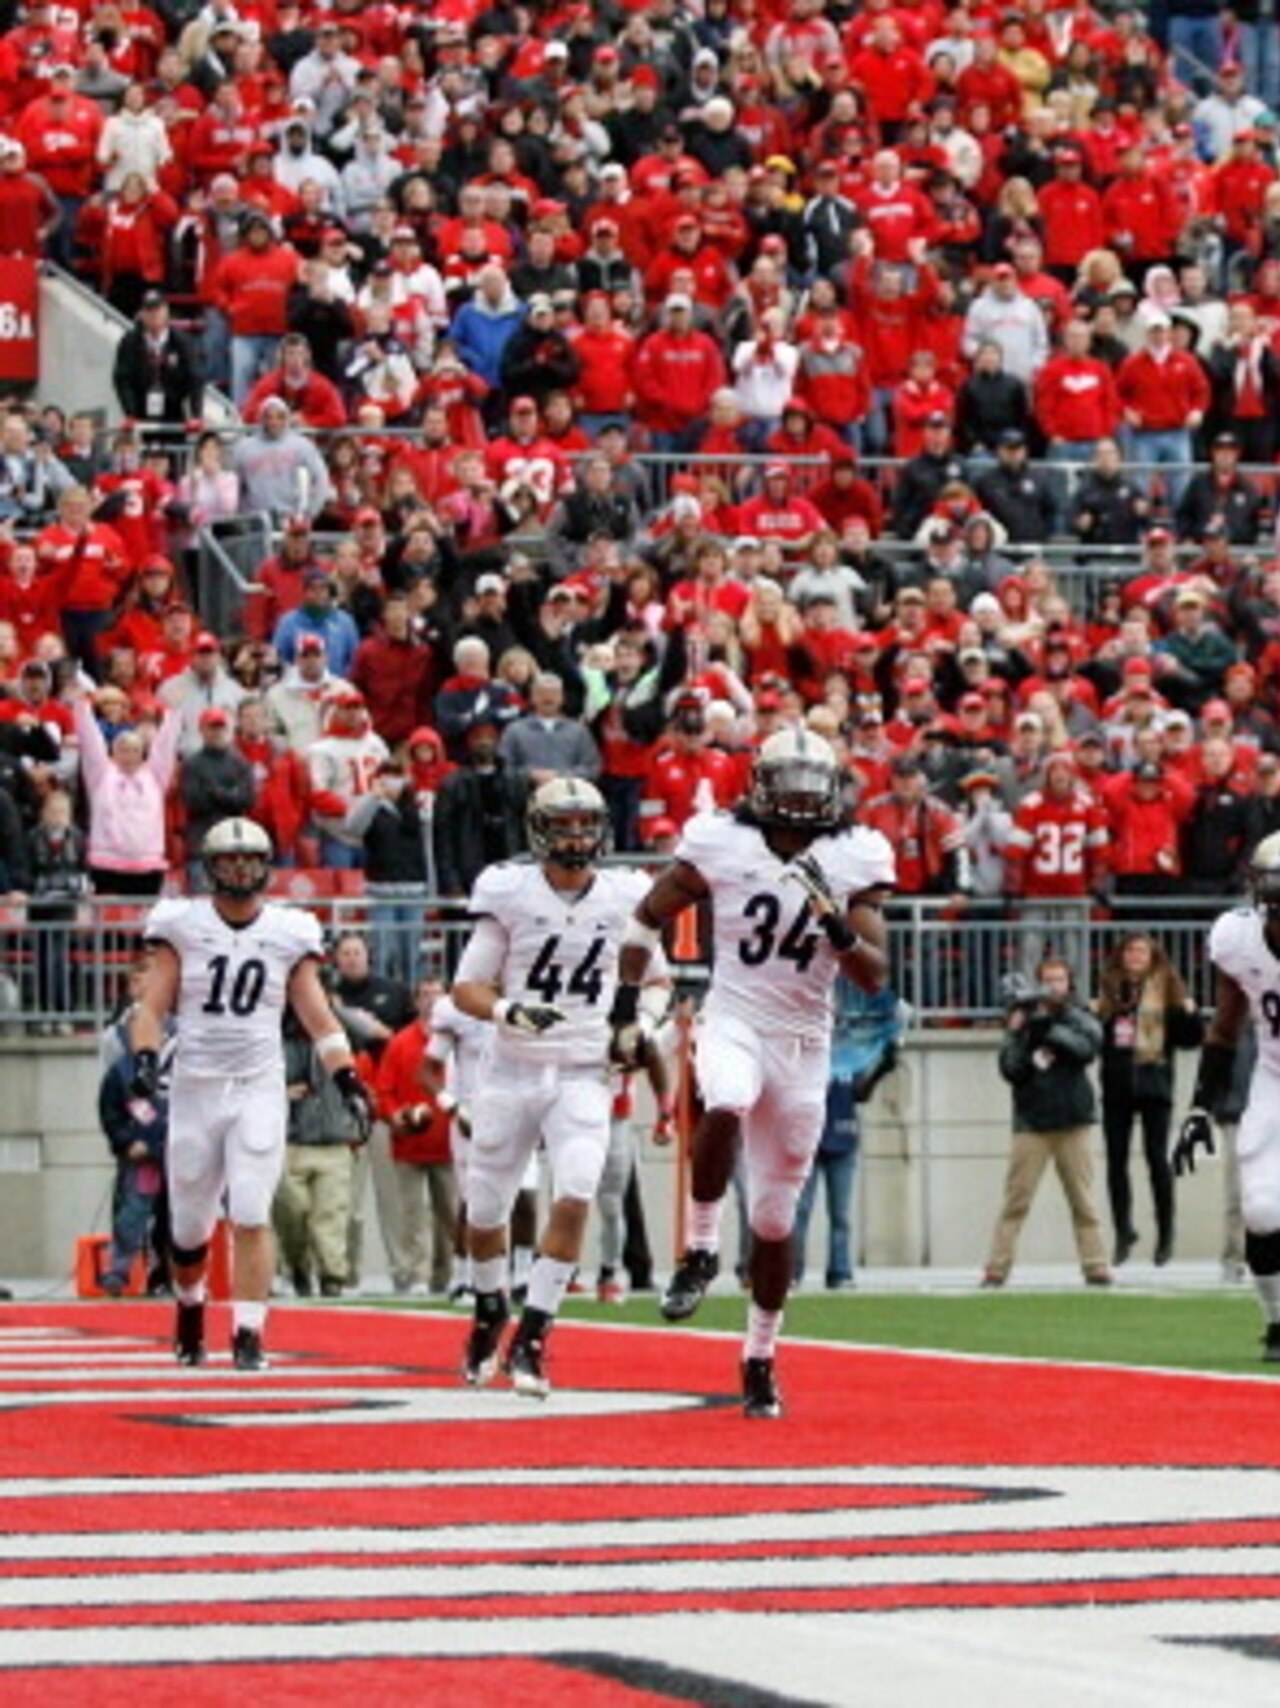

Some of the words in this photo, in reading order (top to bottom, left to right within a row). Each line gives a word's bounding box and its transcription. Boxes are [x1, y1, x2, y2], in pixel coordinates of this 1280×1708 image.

[1034, 820, 1086, 875] 32
[738, 892, 820, 973] 34
[202, 954, 267, 1017] 10
[526, 933, 607, 1004] 44
